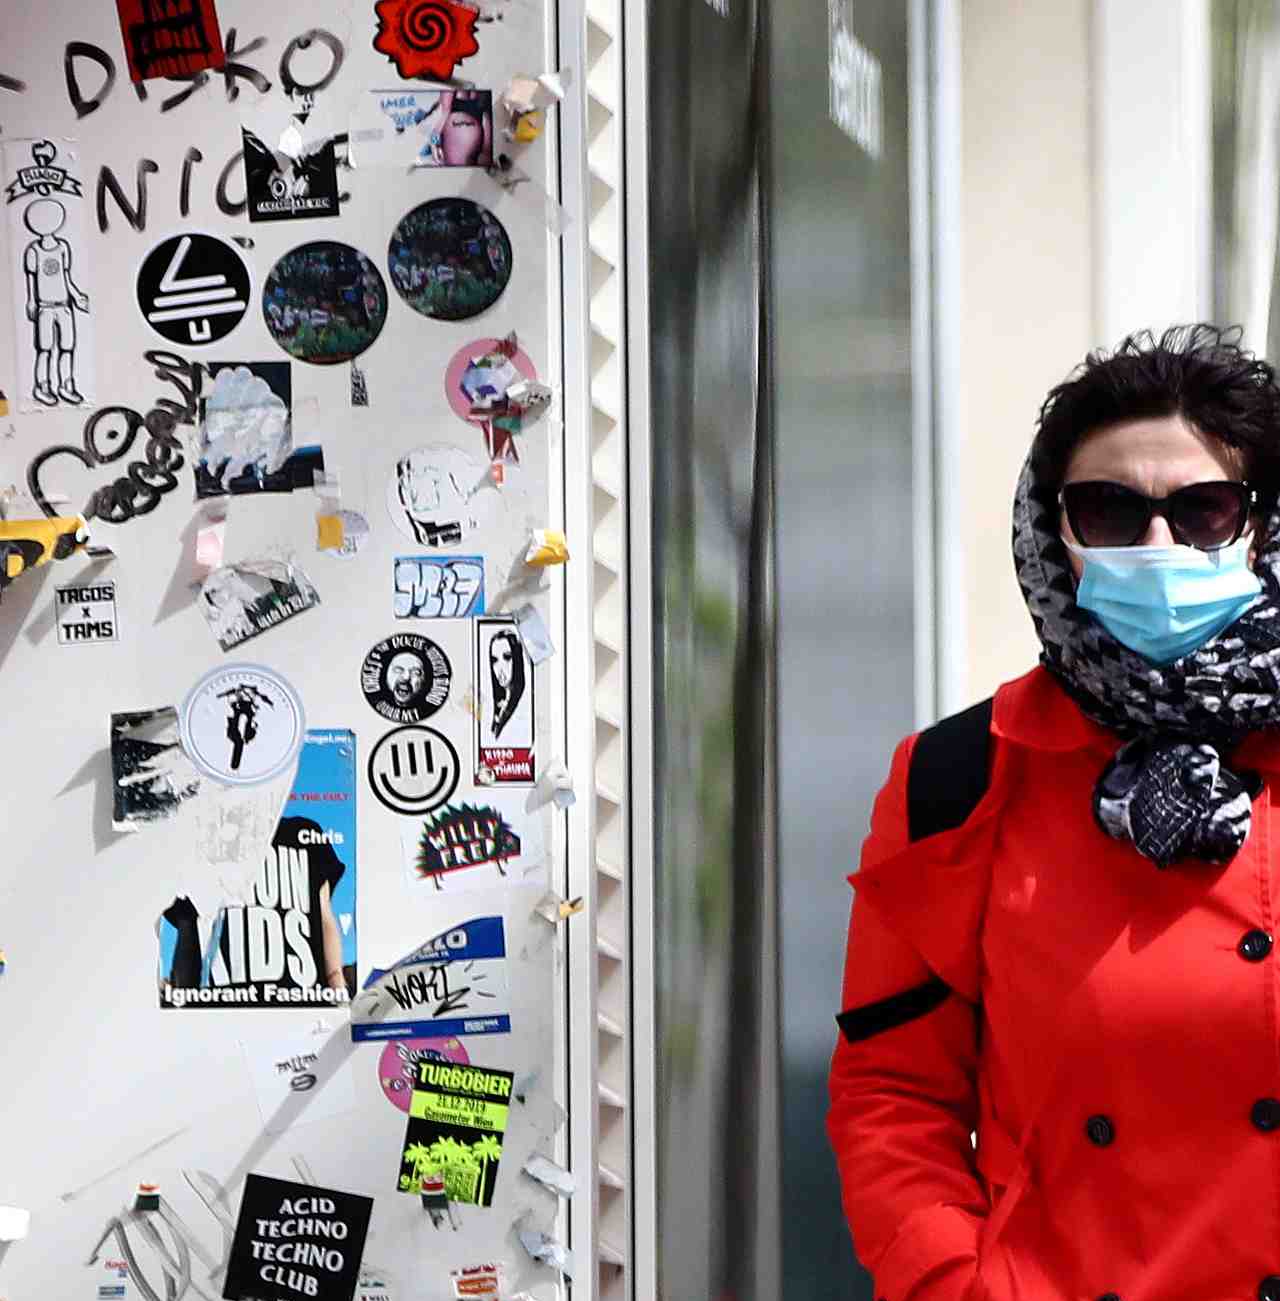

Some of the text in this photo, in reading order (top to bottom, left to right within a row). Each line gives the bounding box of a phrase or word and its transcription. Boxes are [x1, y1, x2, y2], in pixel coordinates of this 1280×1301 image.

[65, 27, 345, 118] DKO
[62, 621, 113, 639] TAMS
[298, 829, 345, 845] Chris
[254, 845, 311, 914] OIN
[197, 906, 318, 988] KIDS
[165, 983, 350, 1007] Ignorant Fashion
[418, 1061, 512, 1097] TURBOBIER
[279, 1197, 336, 1215] ACID
[255, 1218, 349, 1240] TECHNO
[250, 1240, 345, 1272] TECHNO
[259, 1264, 319, 1297] CLUB
